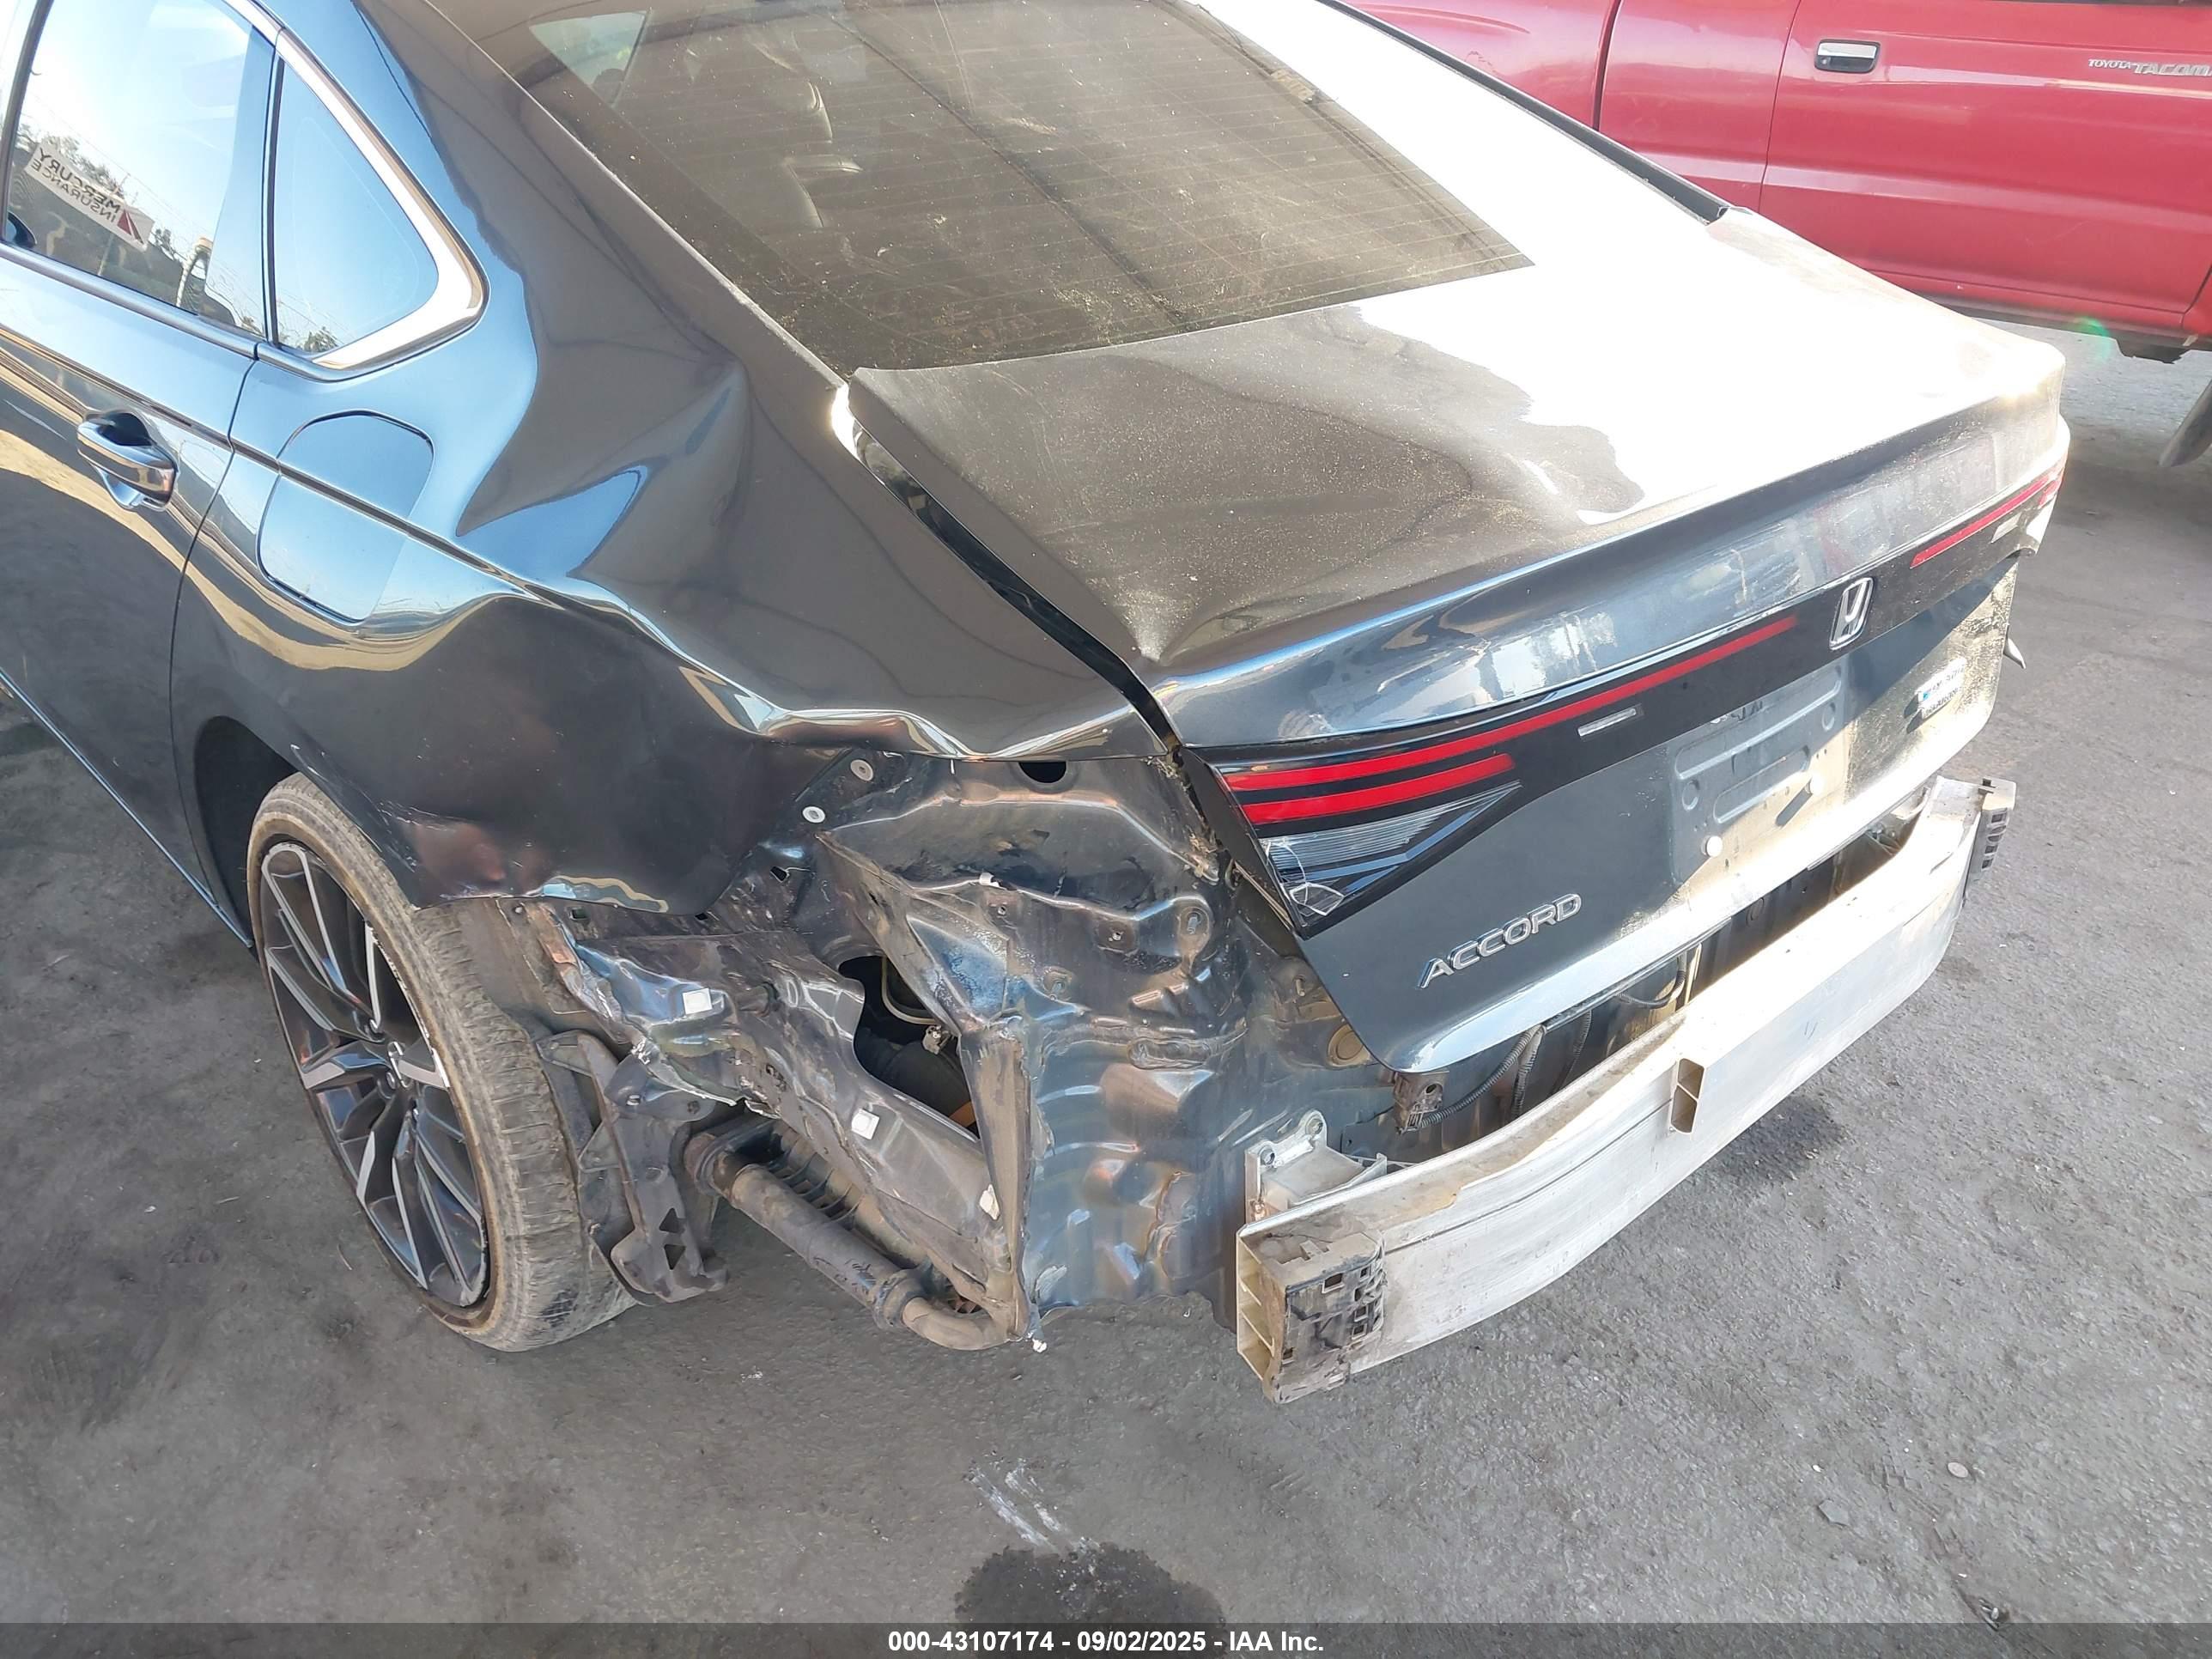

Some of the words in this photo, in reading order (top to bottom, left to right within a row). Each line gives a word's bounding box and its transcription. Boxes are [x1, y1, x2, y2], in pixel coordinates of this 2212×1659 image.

[2088, 58, 2131, 70] TOYOTA
[2133, 62, 2212, 76] TACOM
[1417, 893, 1582, 989] ACCORD
